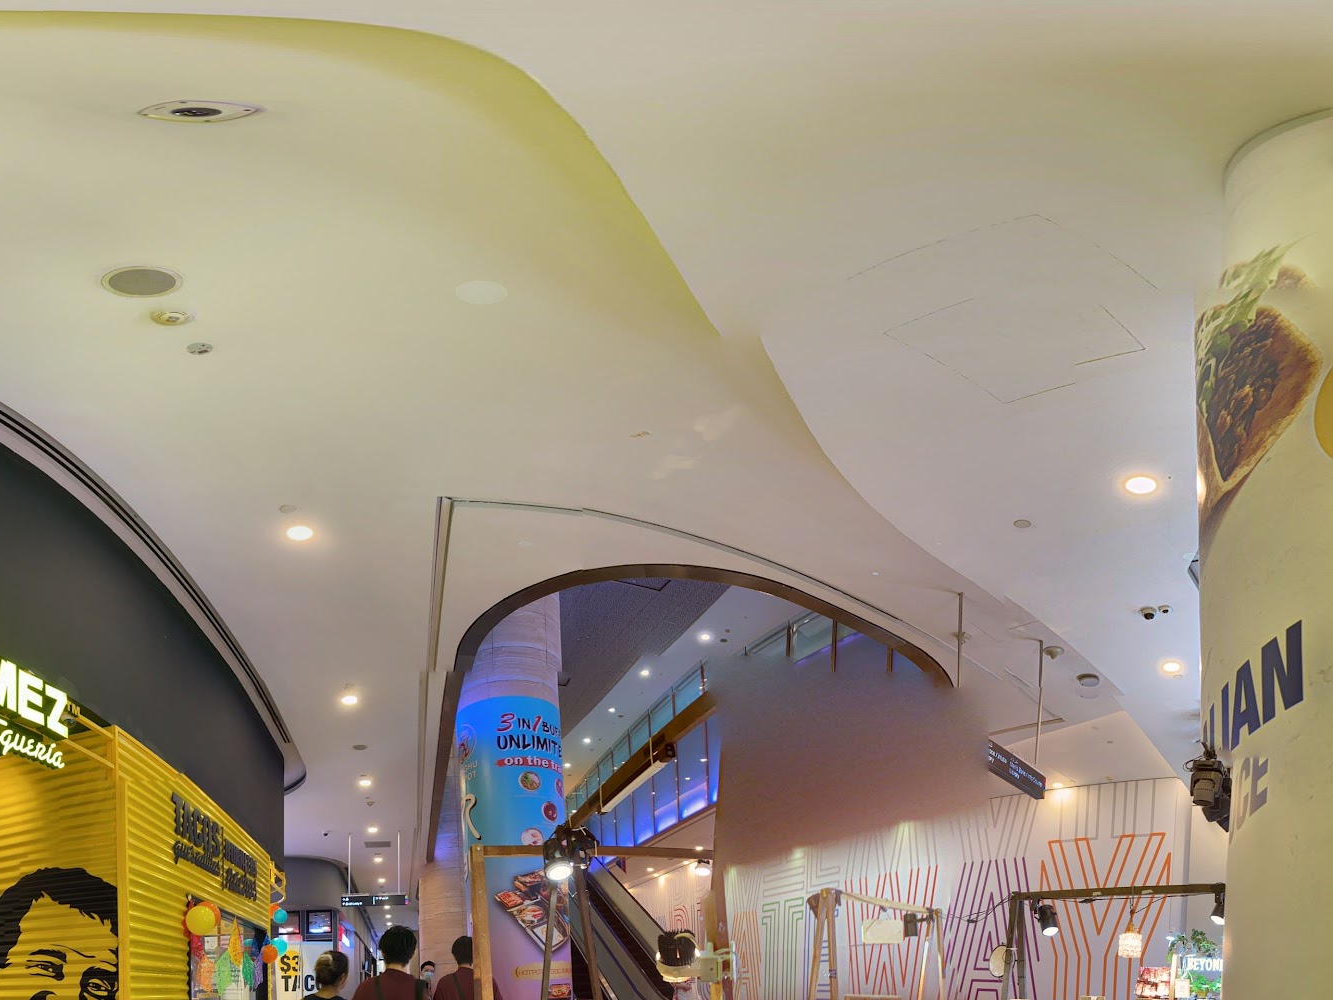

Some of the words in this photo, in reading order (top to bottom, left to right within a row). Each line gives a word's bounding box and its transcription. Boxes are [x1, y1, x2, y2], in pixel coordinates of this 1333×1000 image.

[496, 712, 515, 732] 3
[517, 717, 531, 730] IN
[532, 715, 541, 732] 1
[504, 756, 523, 766] on
[526, 755, 549, 768] the
[171, 791, 220, 858] TACOS
